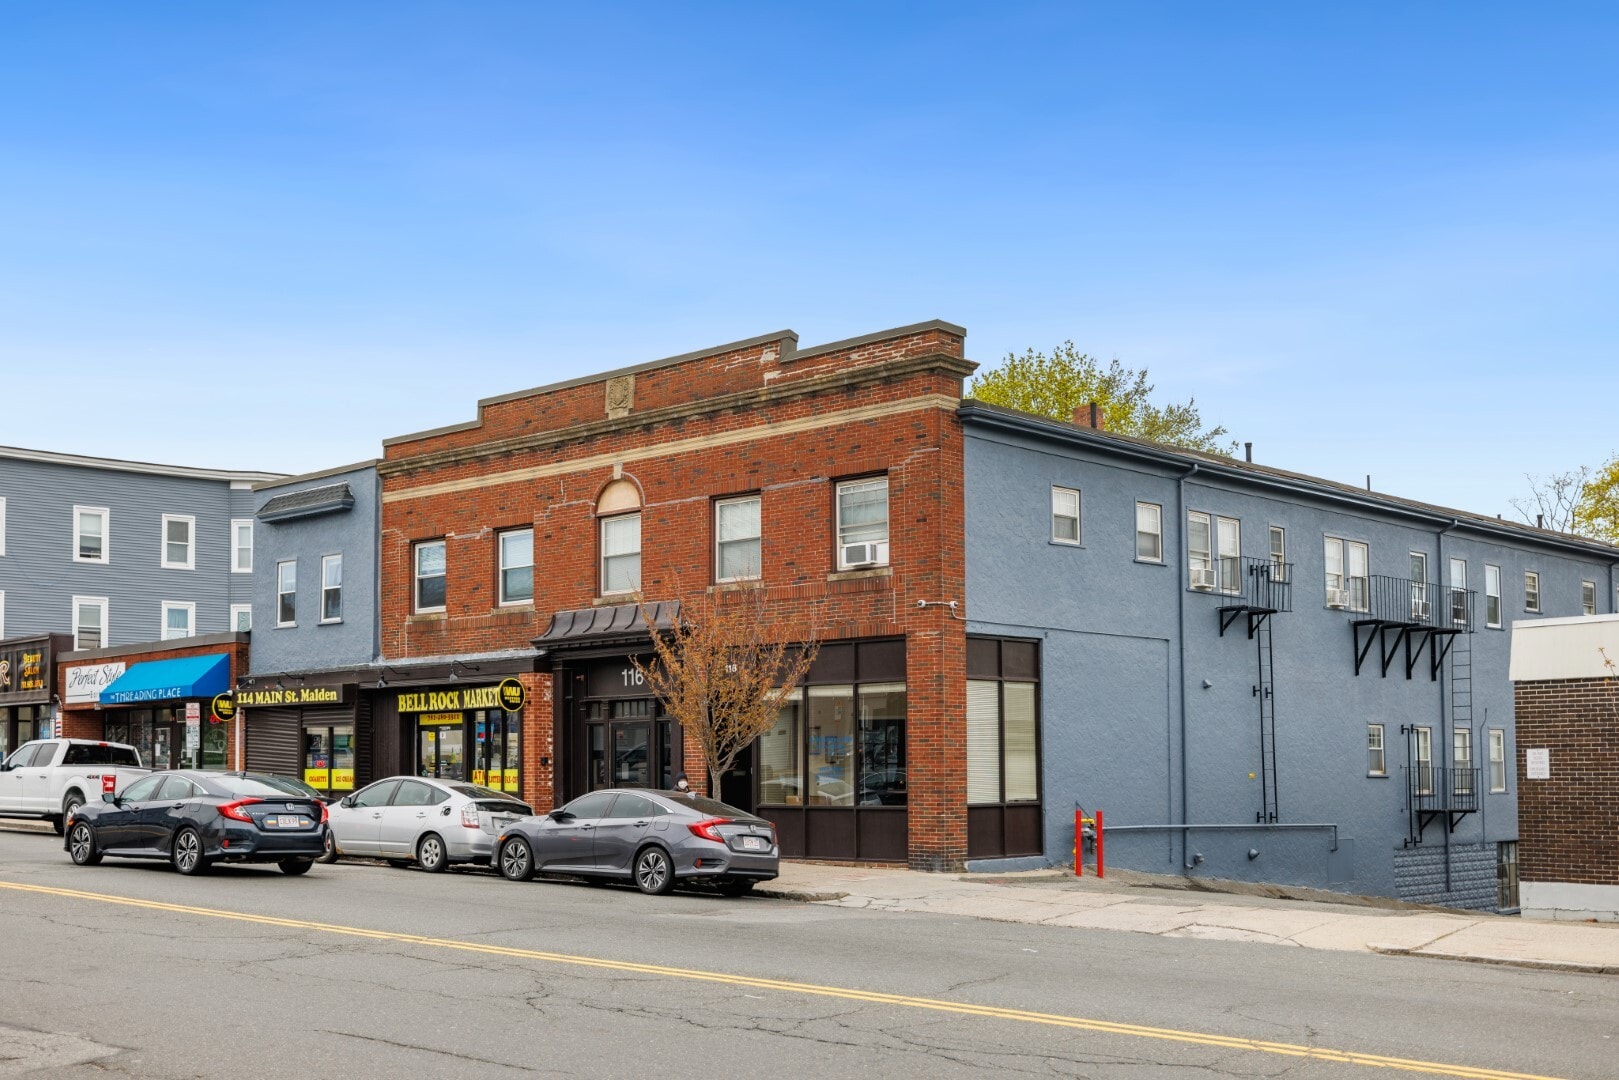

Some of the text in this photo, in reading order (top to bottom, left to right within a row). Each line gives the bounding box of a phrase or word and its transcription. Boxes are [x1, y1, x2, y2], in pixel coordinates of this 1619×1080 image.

[69, 667, 99, 689] Perfect
[622, 668, 644, 686] 116
[115, 689, 157, 703] THREADING
[158, 687, 181, 699] PLACE
[237, 688, 338, 704] 114 MAIN St. Malden
[398, 687, 501, 712] BELL ROCK MARKET
